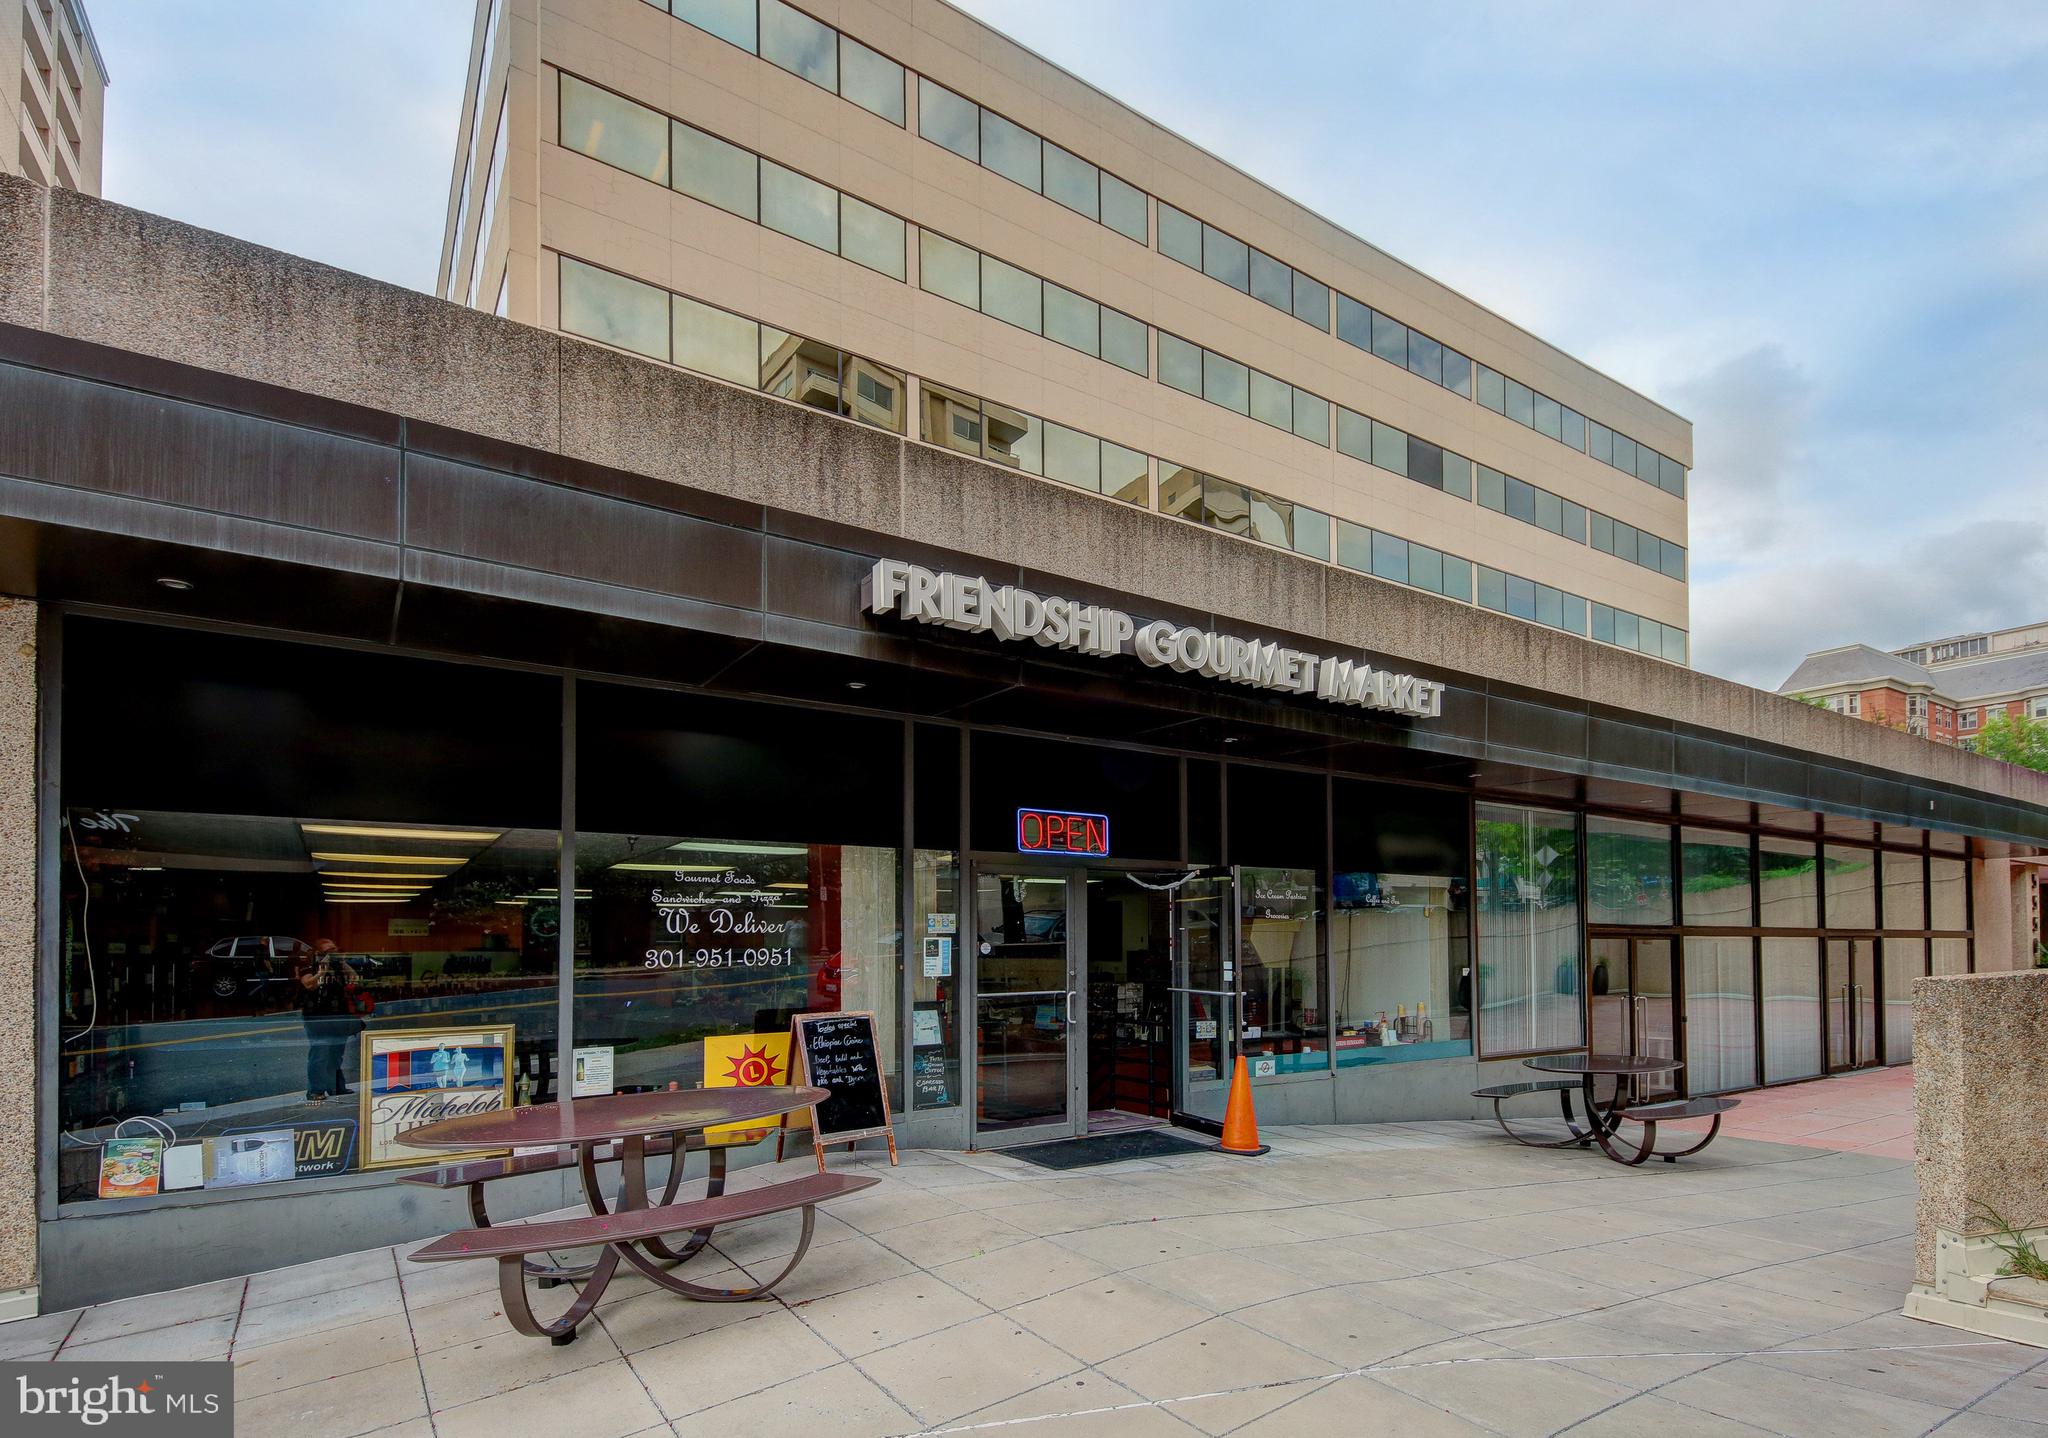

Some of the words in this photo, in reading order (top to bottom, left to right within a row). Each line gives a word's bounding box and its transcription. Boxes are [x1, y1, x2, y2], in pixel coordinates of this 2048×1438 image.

[873, 558, 1134, 658] FRIENDSHIP
[1135, 620, 1319, 694] GOURMET
[1317, 656, 1445, 718] MARKET
[1021, 813, 1106, 852] OPEN
[674, 869, 720, 884] Gourmet
[724, 870, 756, 885] Foods
[651, 888, 716, 904] Sandwiches
[722, 892, 742, 904] and
[750, 889, 781, 907] Pizza
[1255, 889, 1266, 899] Ice
[1266, 889, 1285, 900] Cream
[658, 907, 701, 934] We
[709, 908, 786, 934] Deliver
[644, 948, 792, 969] 301-951-0951
[371, 1092, 504, 1125] Michelob
